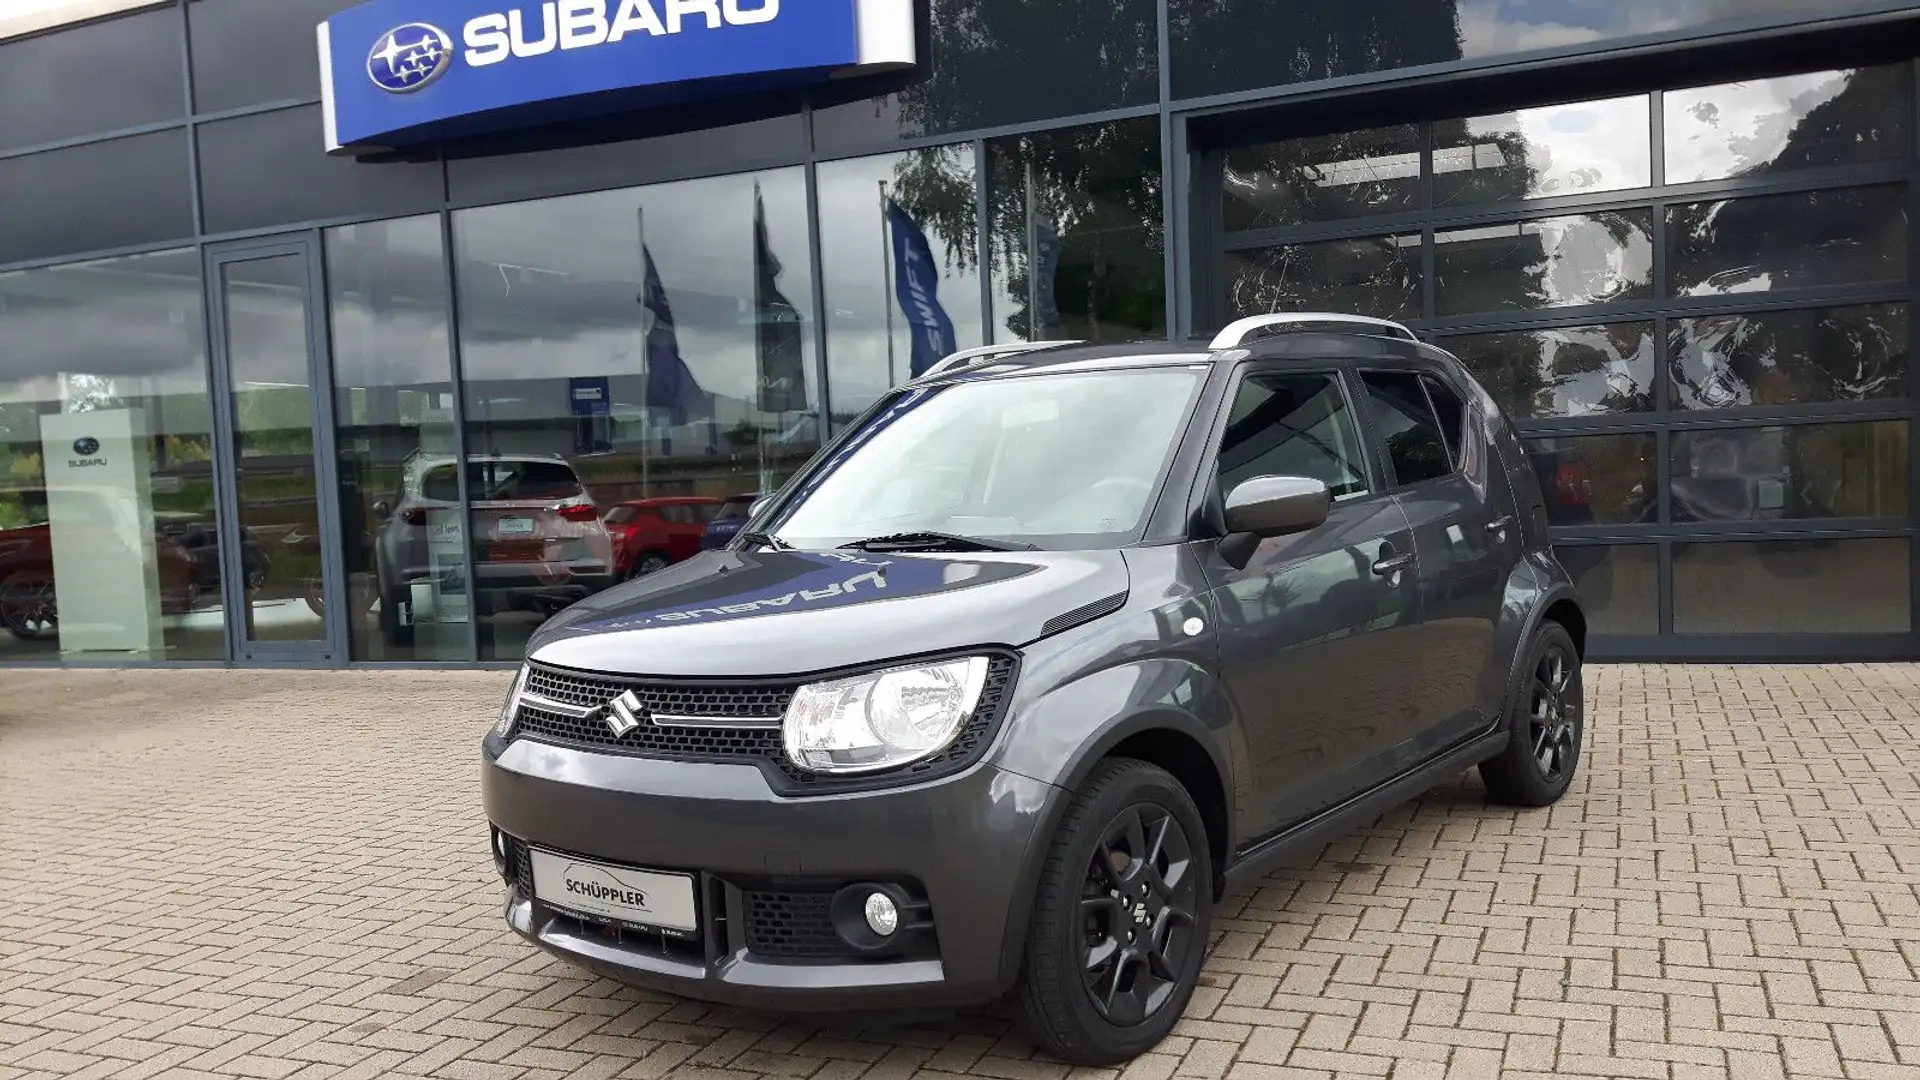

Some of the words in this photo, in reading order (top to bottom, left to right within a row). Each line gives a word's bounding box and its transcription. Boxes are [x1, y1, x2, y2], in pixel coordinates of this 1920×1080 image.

[463, 0, 780, 67] SUBARU
[904, 237, 945, 357] SWIFT
[68, 458, 107, 468] SUBARU
[566, 878, 645, 907] SCHÜPPLER
